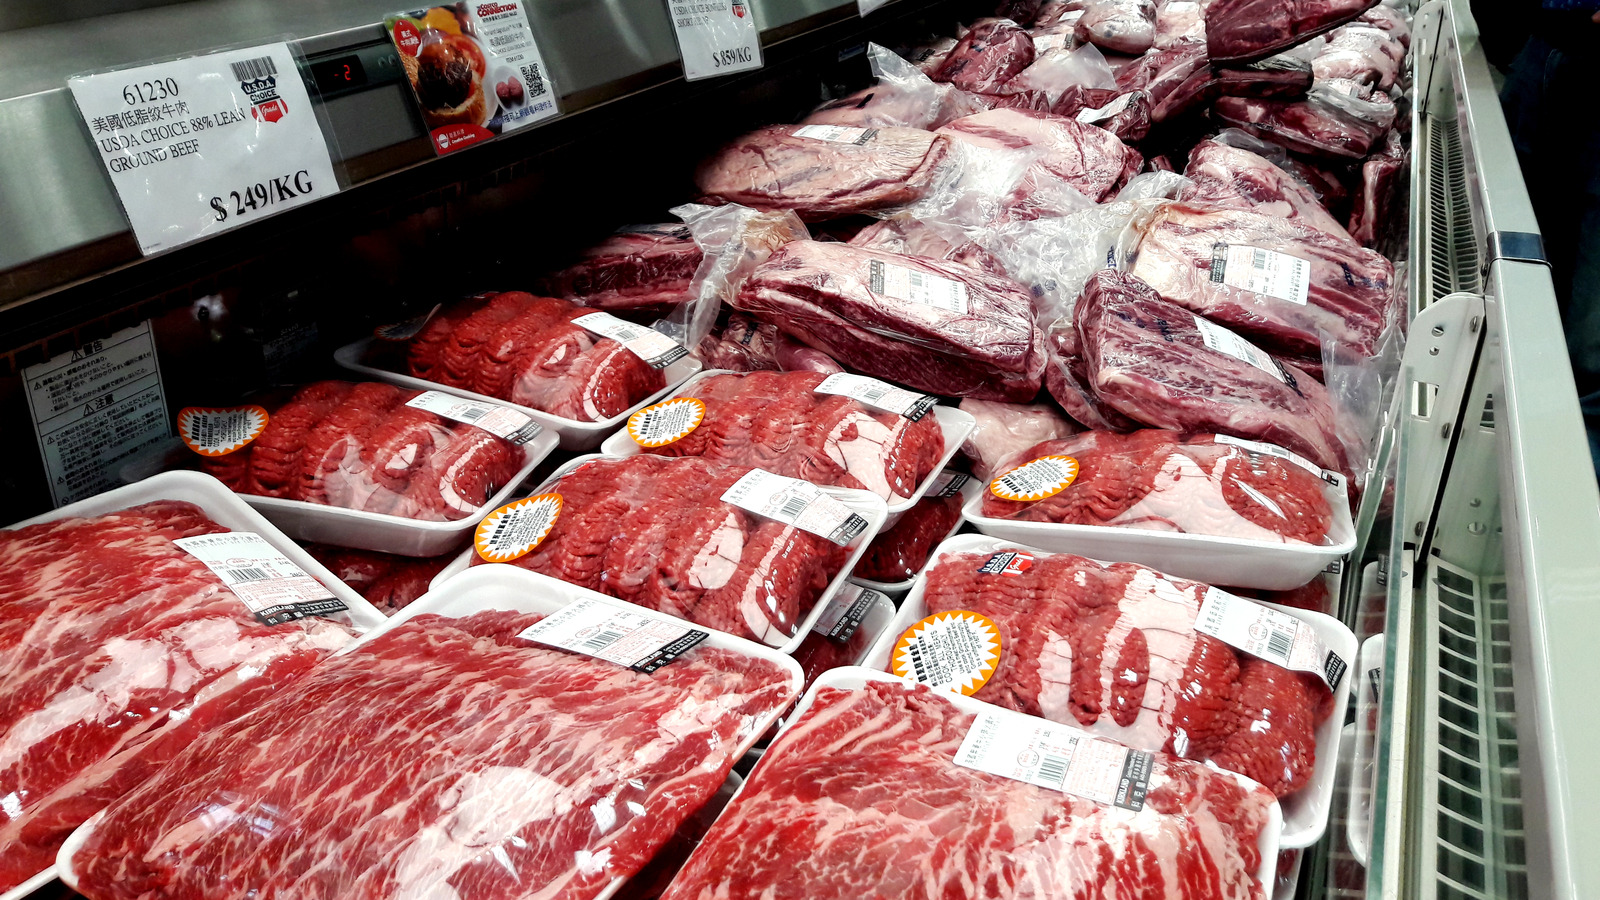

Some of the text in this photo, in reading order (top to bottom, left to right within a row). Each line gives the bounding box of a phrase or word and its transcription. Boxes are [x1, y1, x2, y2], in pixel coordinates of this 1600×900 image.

[478, 3, 518, 18] CONNECTION
[720, 46, 752, 66] 859/KG
[122, 77, 179, 106] 61230
[250, 89, 278, 102] CHOICE
[91, 100, 190, 135] 美國低脂絞牛肉
[101, 108, 246, 153] USDA CHOICE 88% LEAN
[109, 138, 200, 174] GROUND BEEF
[210, 169, 314, 222] $ 249/KG
[94, 393, 115, 410] 注意
[260, 604, 295, 616] KIRKLAND
[929, 629, 941, 649] MEATS
[936, 650, 945, 661] ALL
[940, 632, 957, 671] THOROUGHLY
[940, 663, 952, 683] COOK
[1116, 778, 1130, 804] KIRKLAND
